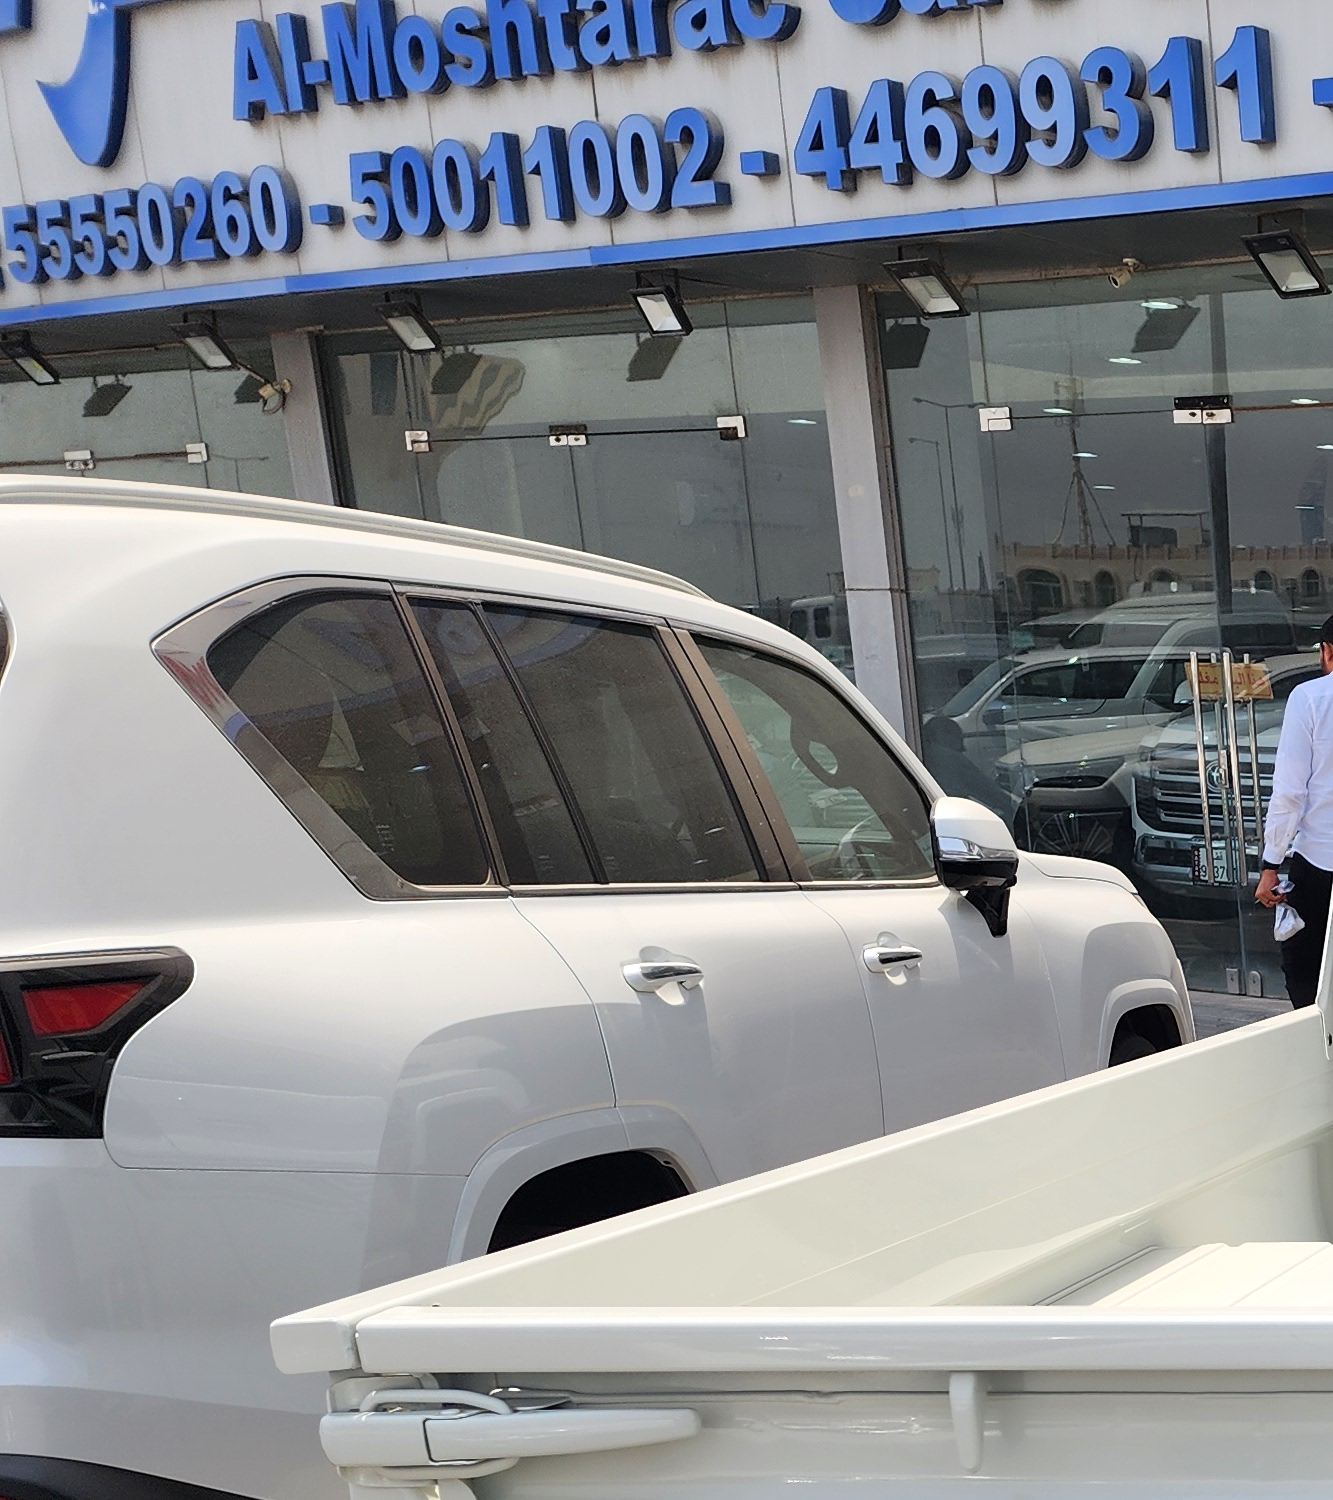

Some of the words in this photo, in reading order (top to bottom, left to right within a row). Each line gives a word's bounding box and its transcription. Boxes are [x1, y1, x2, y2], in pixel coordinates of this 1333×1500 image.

[2, 165, 303, 285] 55550260
[350, 107, 732, 242] 50011002
[794, 25, 1276, 192] 44699311
